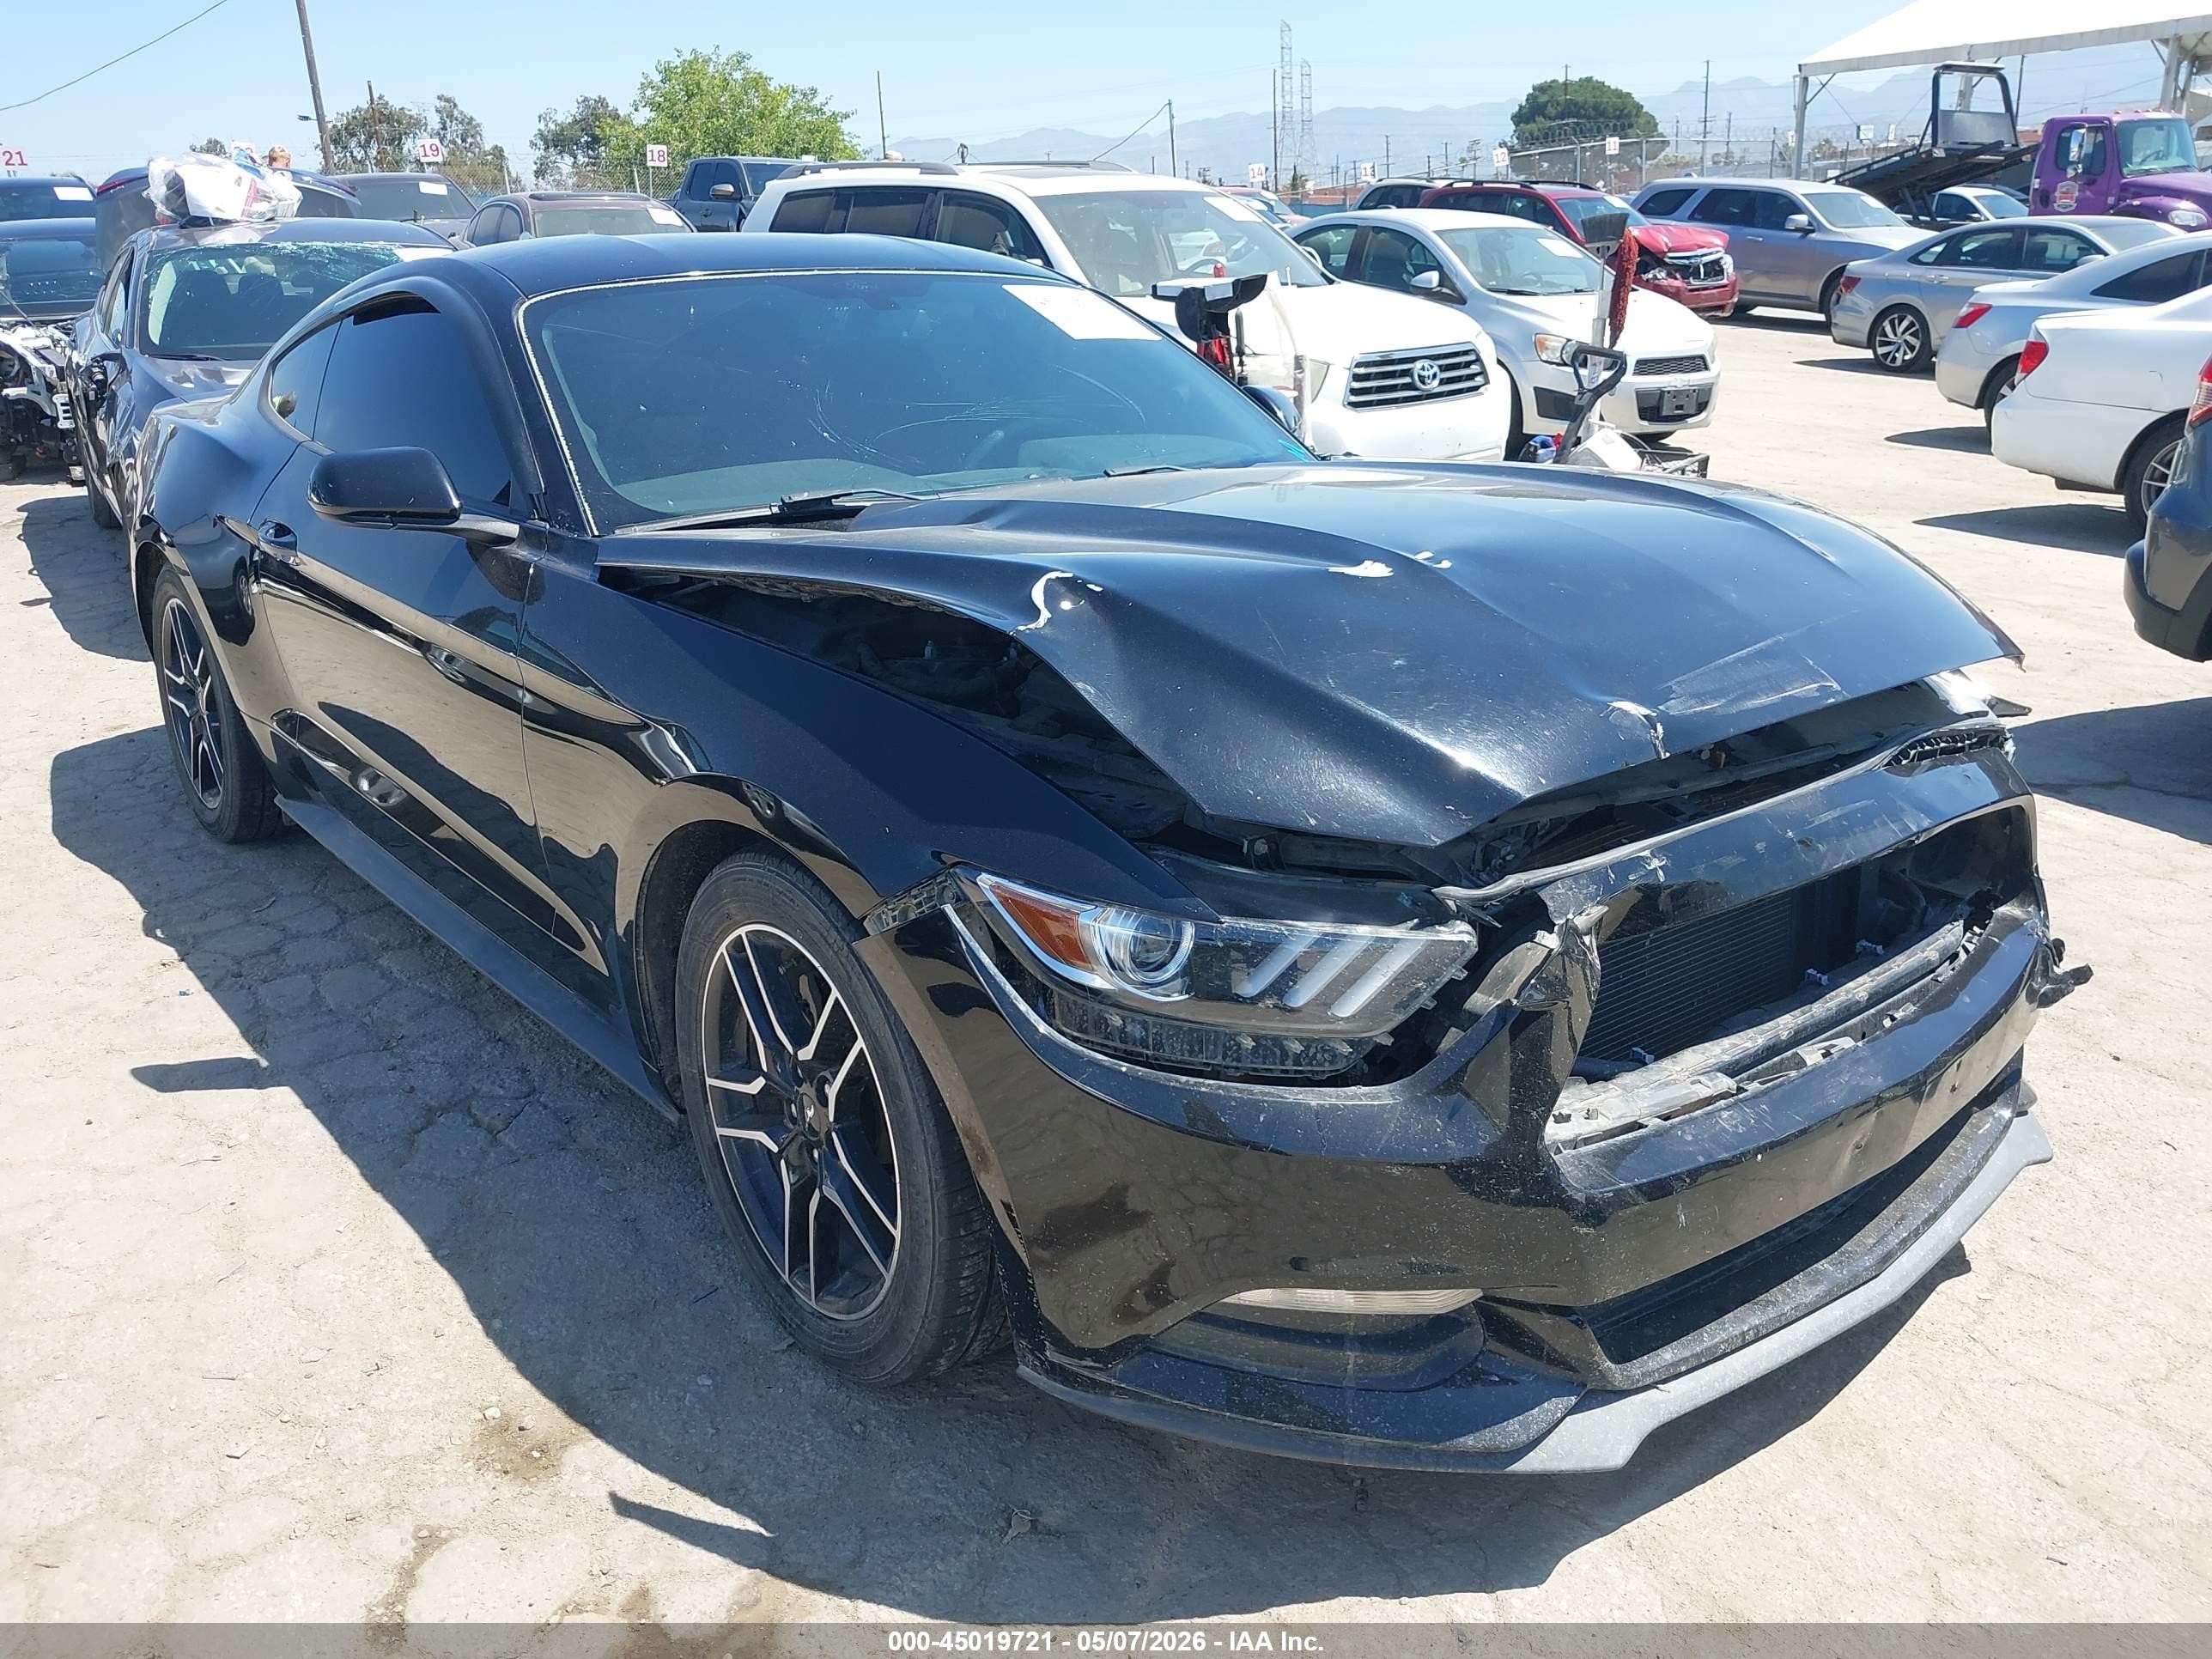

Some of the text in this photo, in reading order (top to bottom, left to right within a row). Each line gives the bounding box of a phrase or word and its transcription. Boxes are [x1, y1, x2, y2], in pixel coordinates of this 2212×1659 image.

[420, 143, 440, 158] 19
[647, 149, 666, 163] 18
[1495, 151, 1507, 163] 12
[3, 150, 27, 167] 21
[1250, 166, 1264, 179] 14
